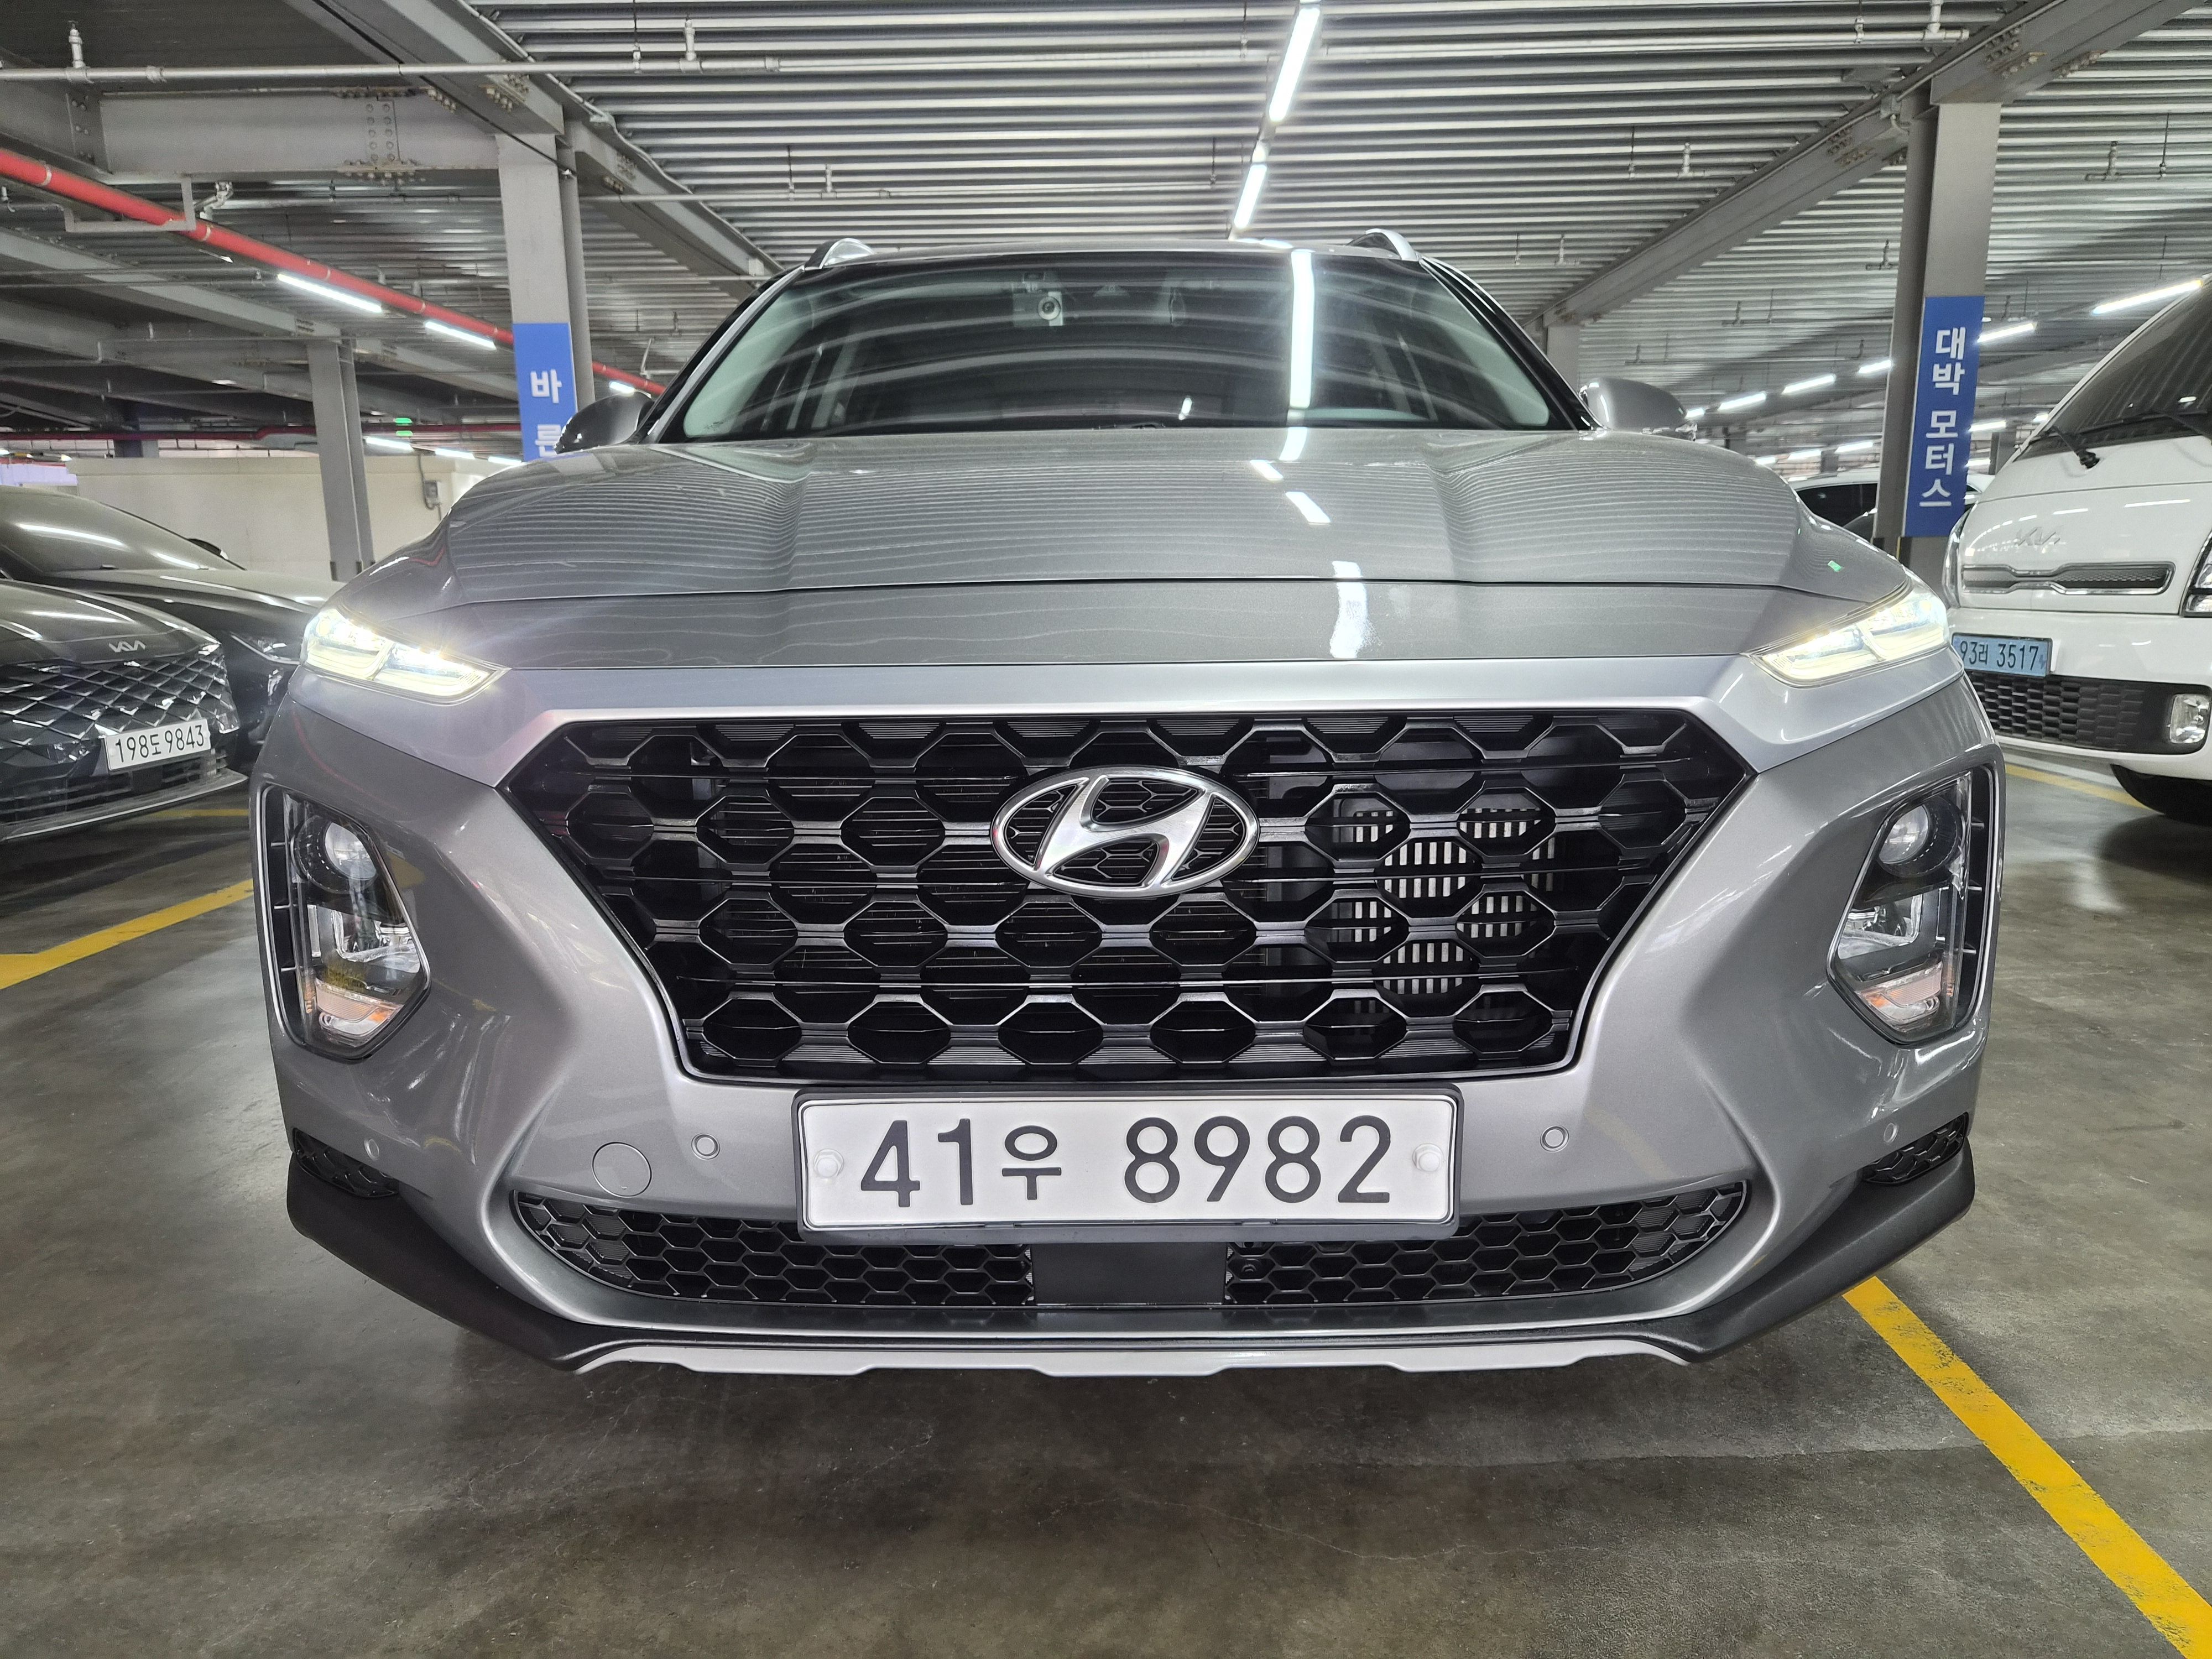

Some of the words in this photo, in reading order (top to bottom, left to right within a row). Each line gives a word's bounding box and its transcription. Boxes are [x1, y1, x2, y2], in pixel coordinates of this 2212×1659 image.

[1933, 327, 1965, 395] 대박
[1919, 410, 1958, 507] 모터스
[1996, 643, 2039, 671] 3517
[115, 734, 161, 763] 198도
[164, 724, 204, 753] 9843
[860, 1118, 1062, 1207] 41우
[1124, 1115, 1391, 1204] 8982
